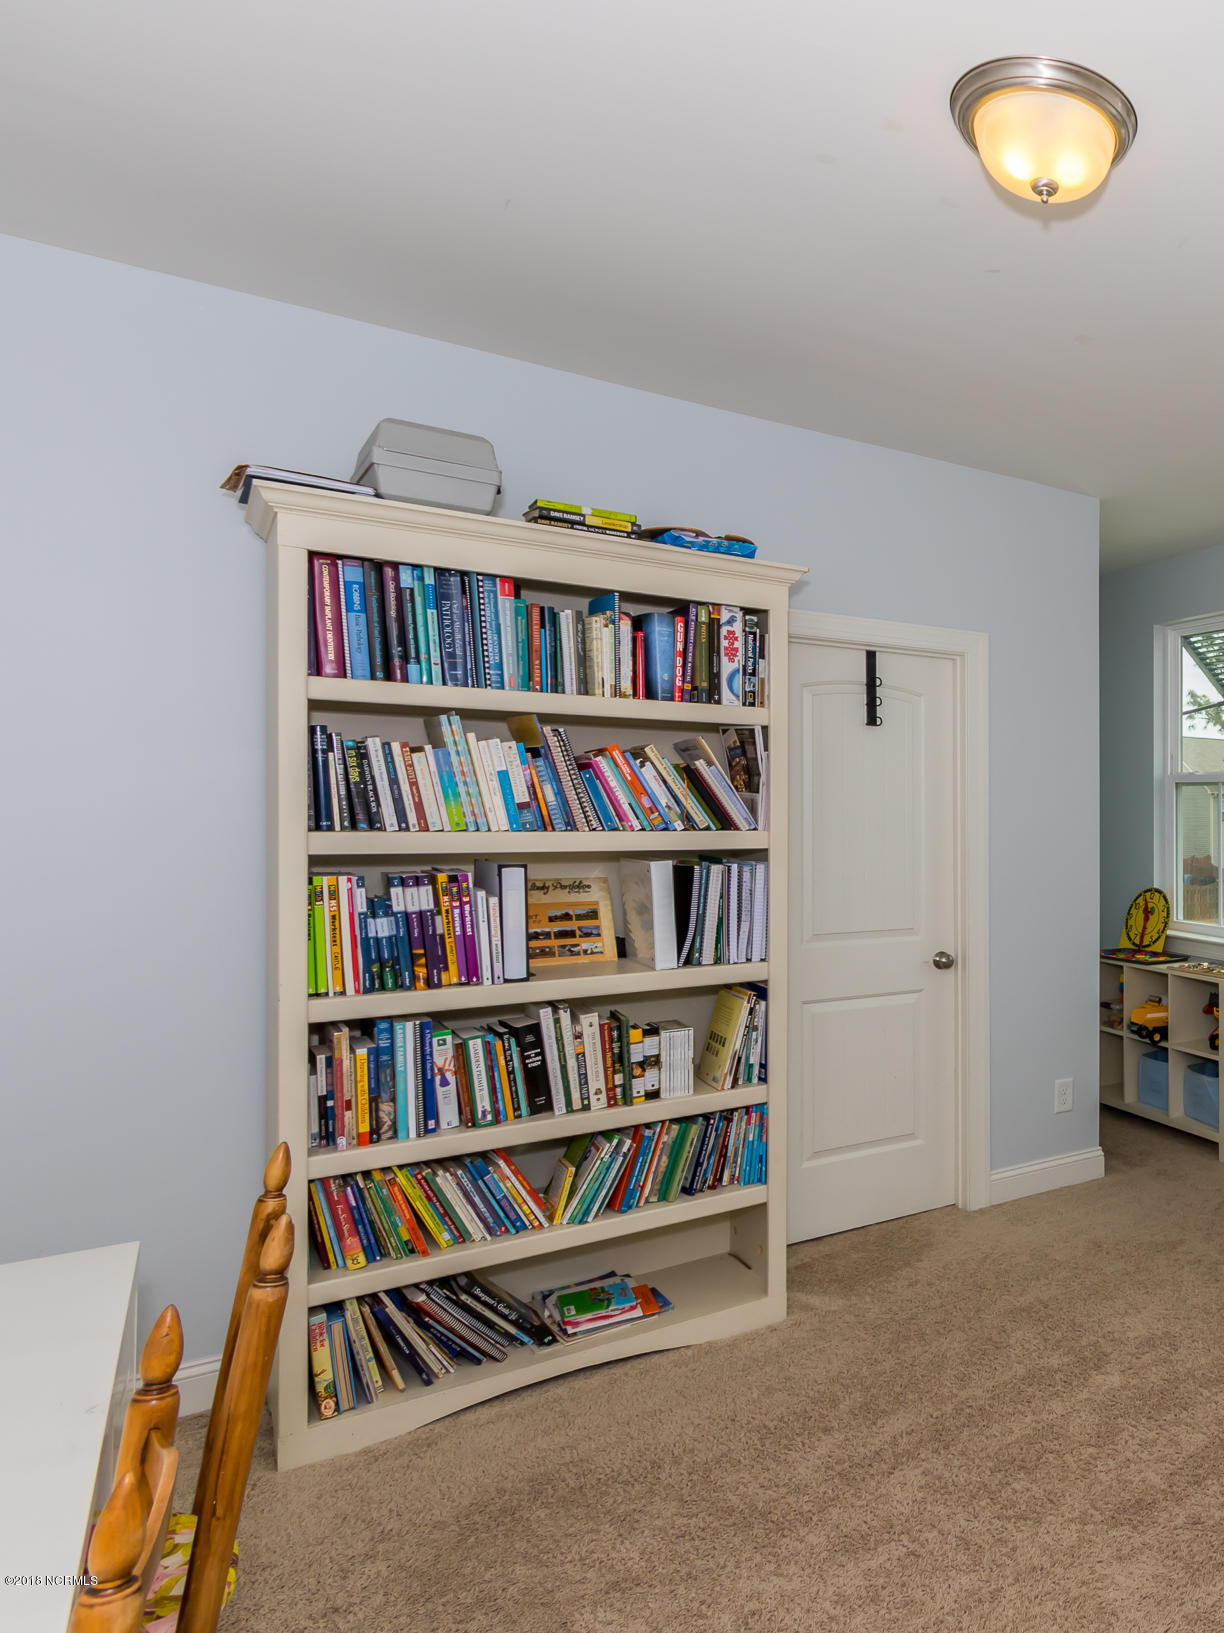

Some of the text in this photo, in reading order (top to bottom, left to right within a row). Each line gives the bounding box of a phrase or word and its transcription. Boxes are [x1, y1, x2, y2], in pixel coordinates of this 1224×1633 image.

[322, 565, 335, 661] CONTEMPORARY IMPLANT DENTISTRY
[440, 600, 453, 654] PATHOLOGY
[676, 622, 684, 652] GUN
[723, 634, 739, 642] BOOK
[348, 757, 358, 767] six
[350, 767, 360, 782] days
[362, 759, 373, 785] DARWIN'S
[367, 785, 376, 802] BLACK
[329, 900, 338, 913] K5
[442, 896, 450, 907] K5
[330, 913, 338, 947] Worktext
[444, 908, 453, 939] Worktext
[453, 908, 461, 936] Reviews
[463, 903, 472, 936] Worktext
[396, 1025, 405, 1071] LARGE FAMILY
[472, 1043, 484, 1093] GARDEN PRIMER
[358, 1058, 368, 1124] Drawing with Children
